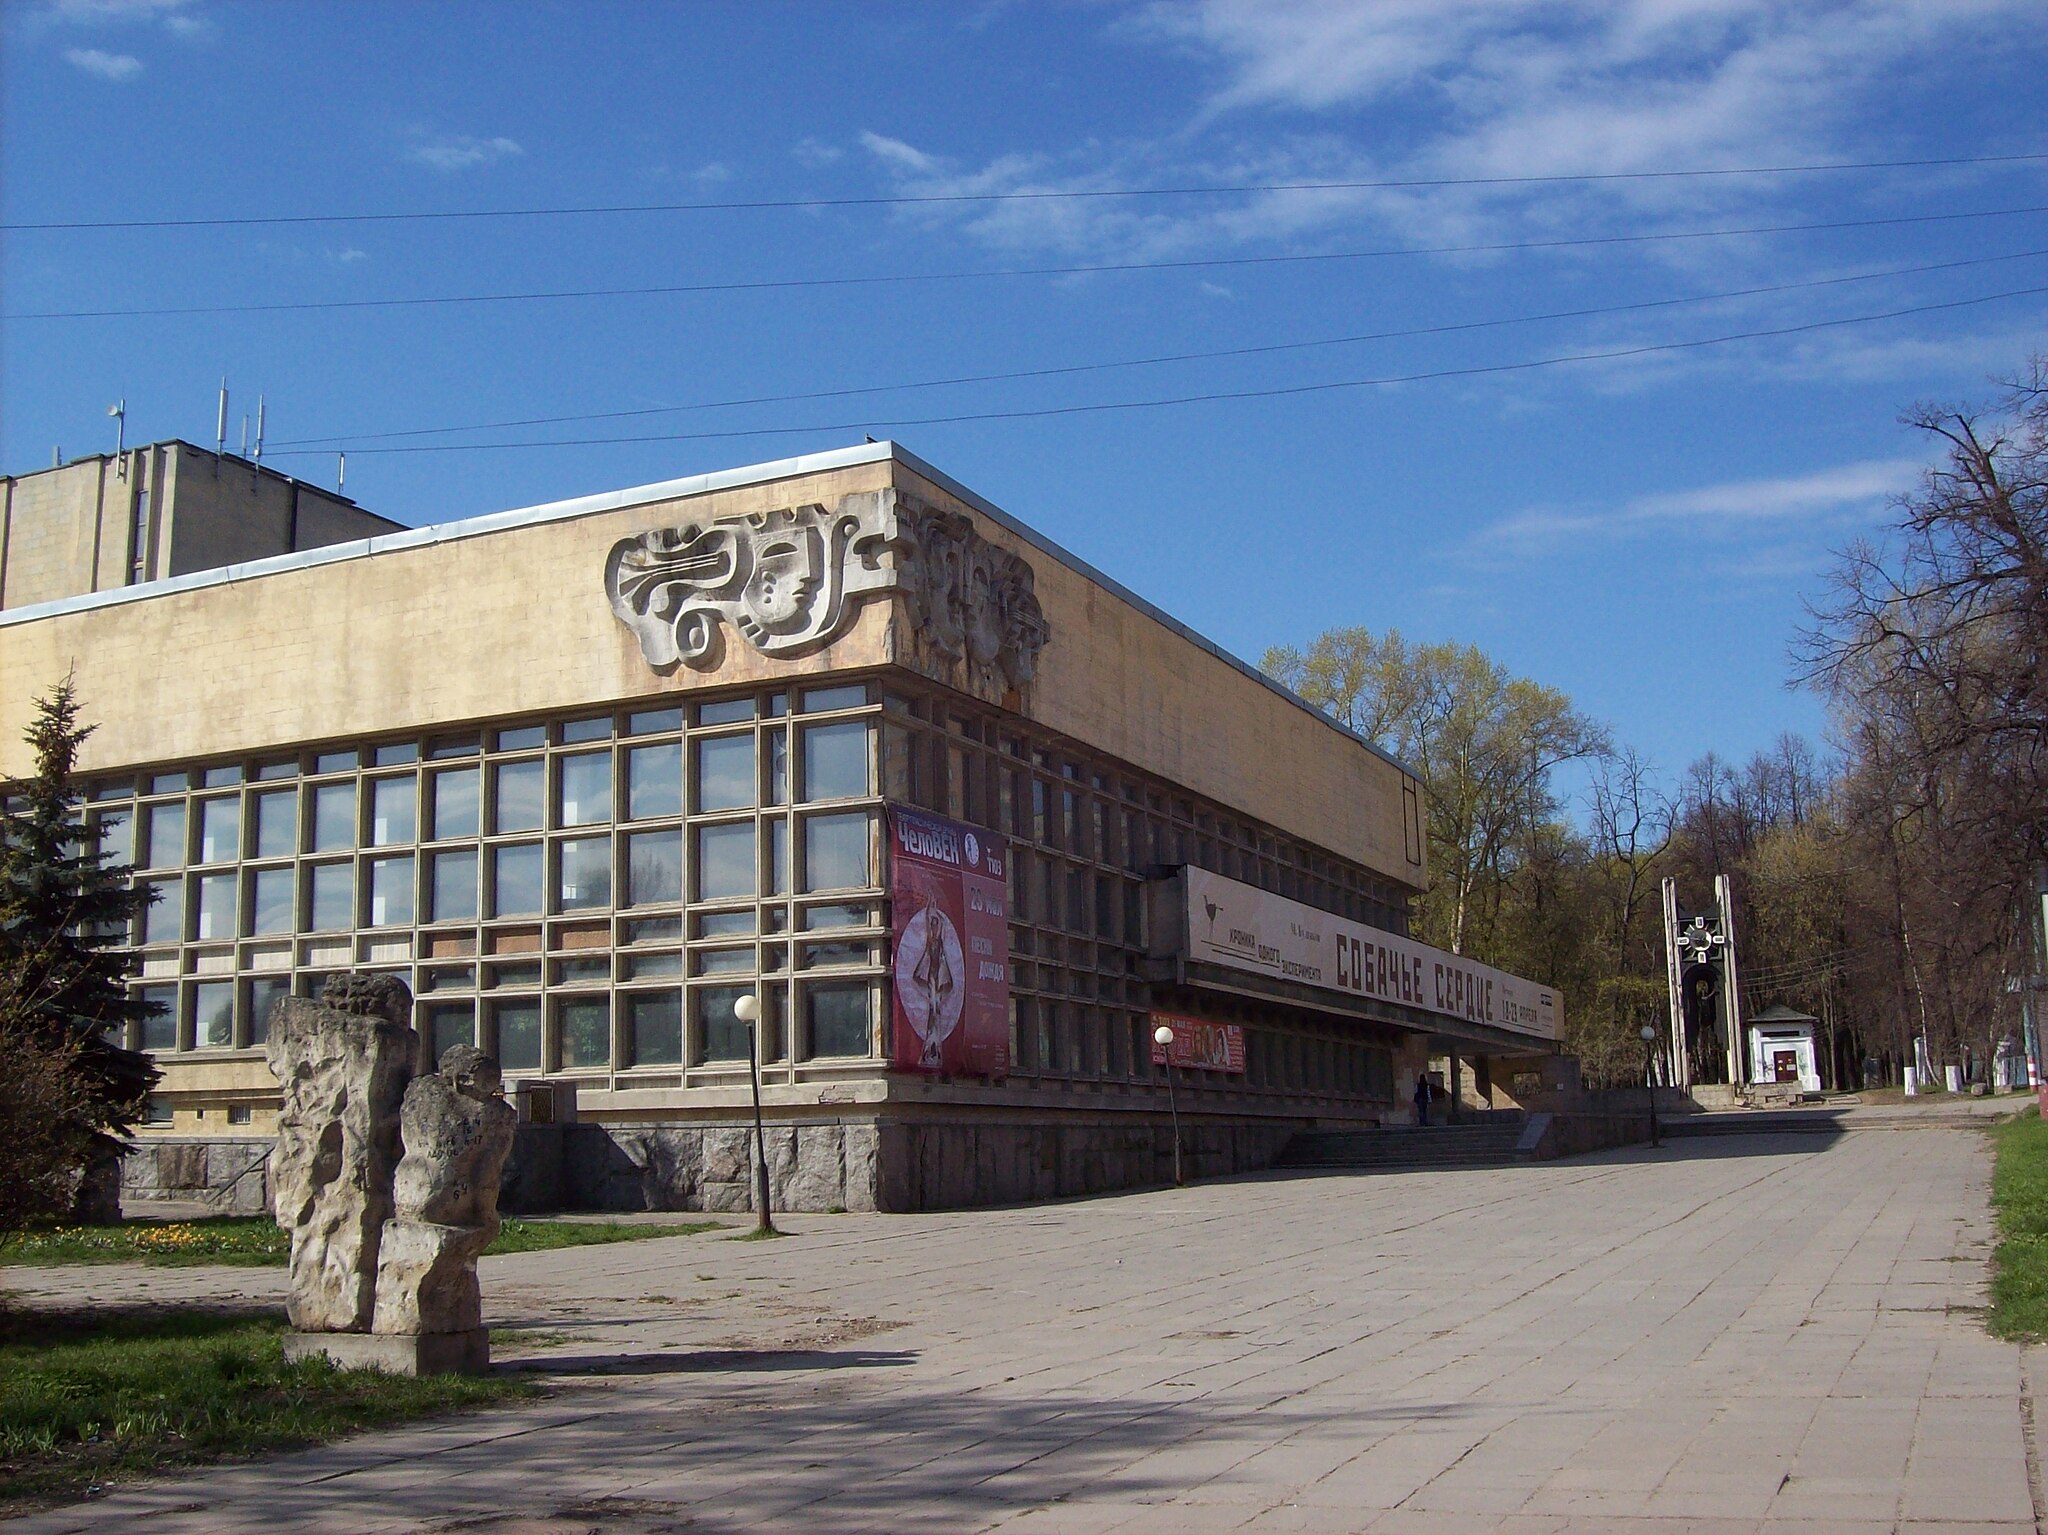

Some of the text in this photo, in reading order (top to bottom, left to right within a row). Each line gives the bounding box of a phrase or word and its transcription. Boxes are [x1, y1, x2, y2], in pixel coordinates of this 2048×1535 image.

[987, 857, 1003, 876] ТЮЗ
[1229, 927, 1256, 949] ХРОНИКА
[1336, 933, 1494, 1024] СОБАЧЬЕ СЕРДЦЕ
